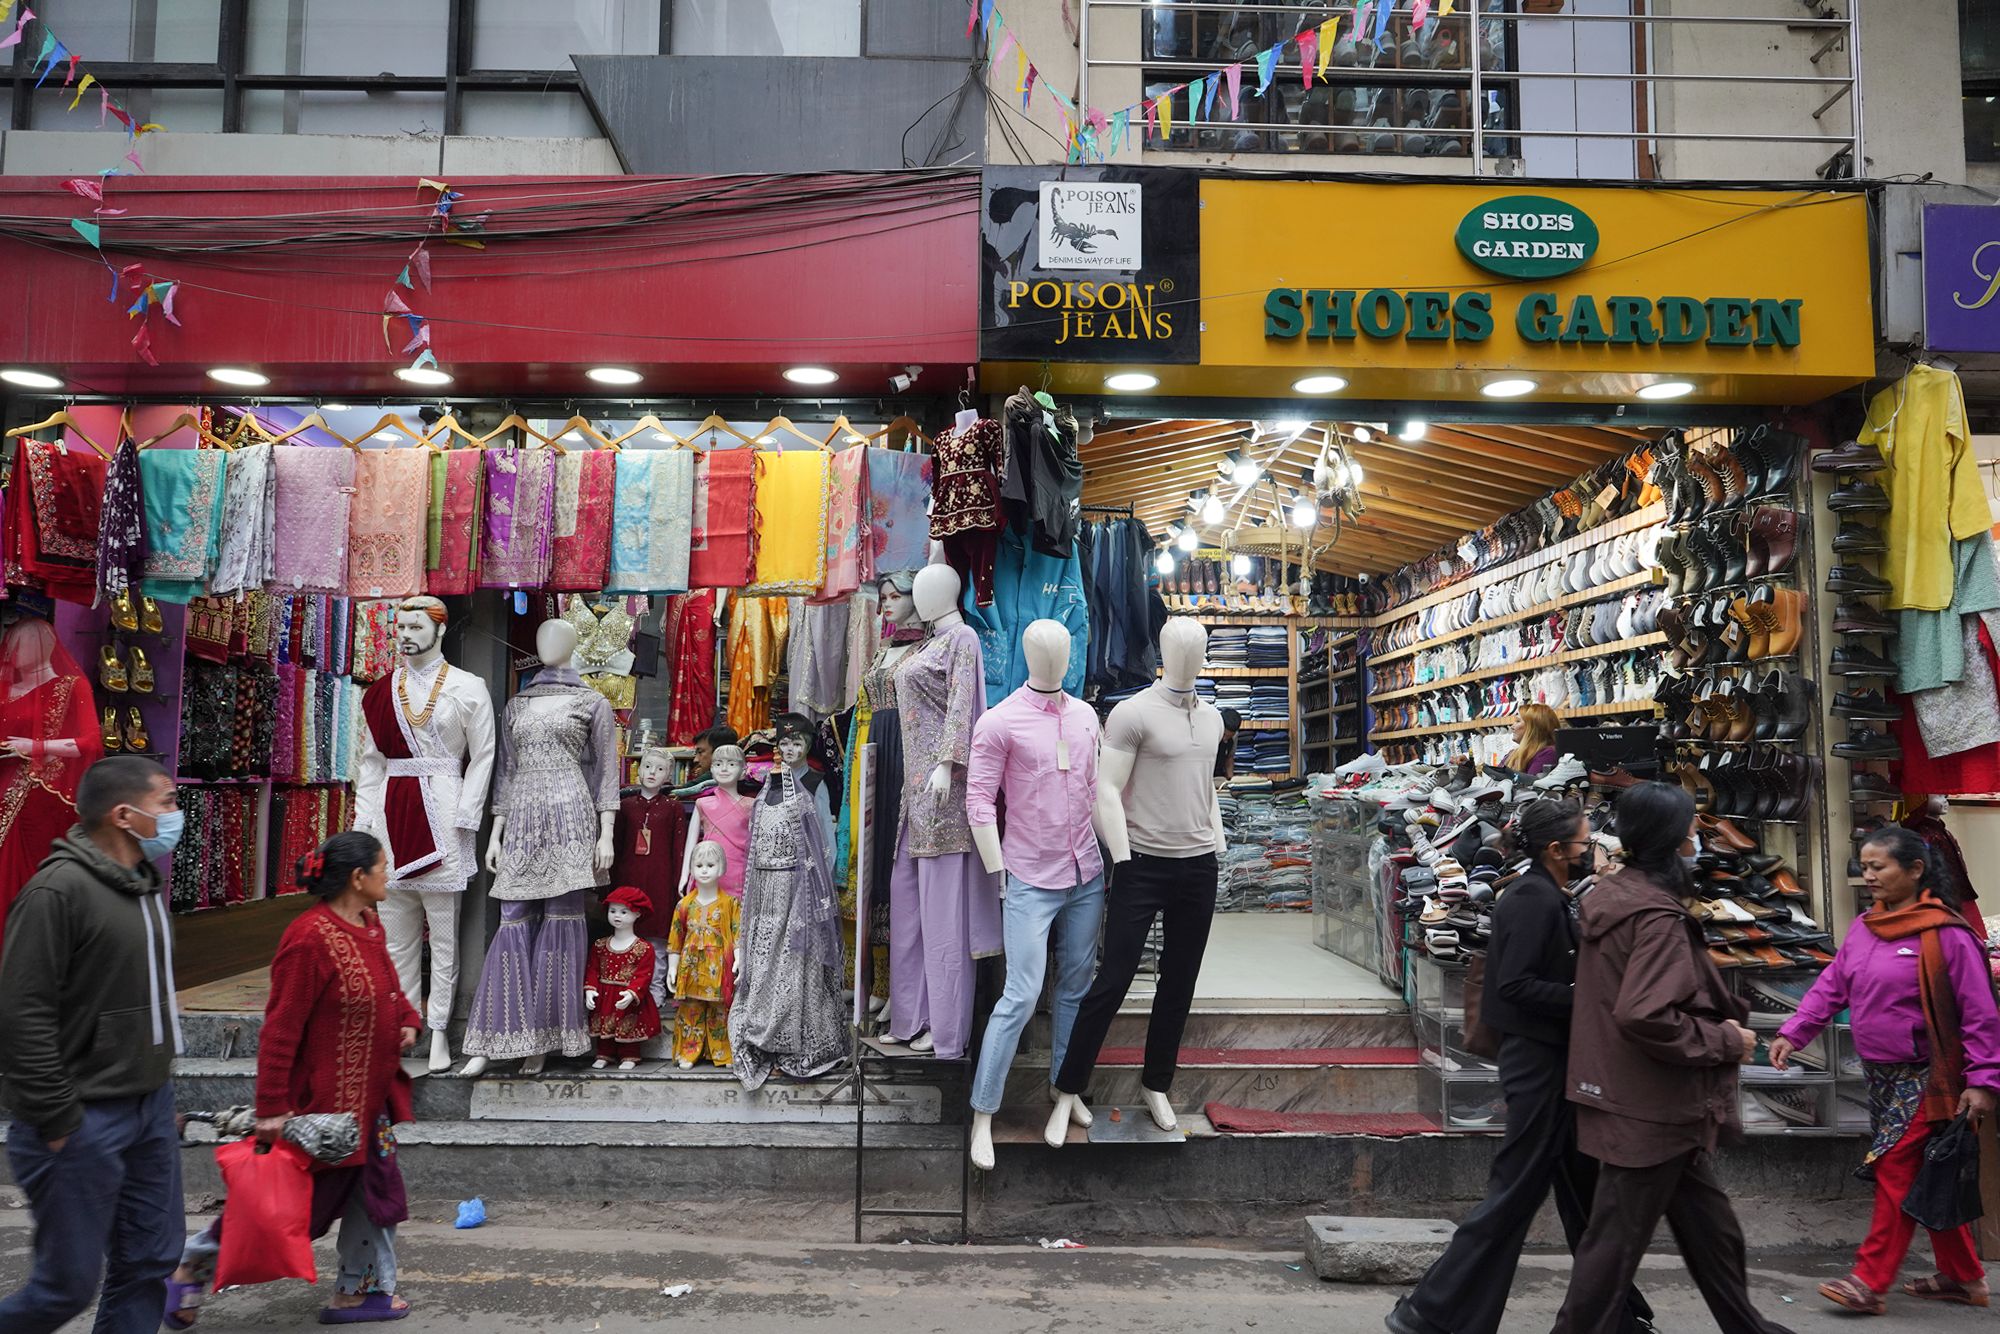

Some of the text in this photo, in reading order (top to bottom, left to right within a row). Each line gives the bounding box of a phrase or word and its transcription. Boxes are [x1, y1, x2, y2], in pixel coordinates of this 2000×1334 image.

[1086, 192, 1136, 215] JEANS
[1482, 212, 1575, 232] SHOES
[1472, 240, 1586, 260] GARDEN
[1048, 256, 1132, 266] DENIM IS WAY OF LIFE
[1264, 288, 1803, 348] SHOES GARDEN
